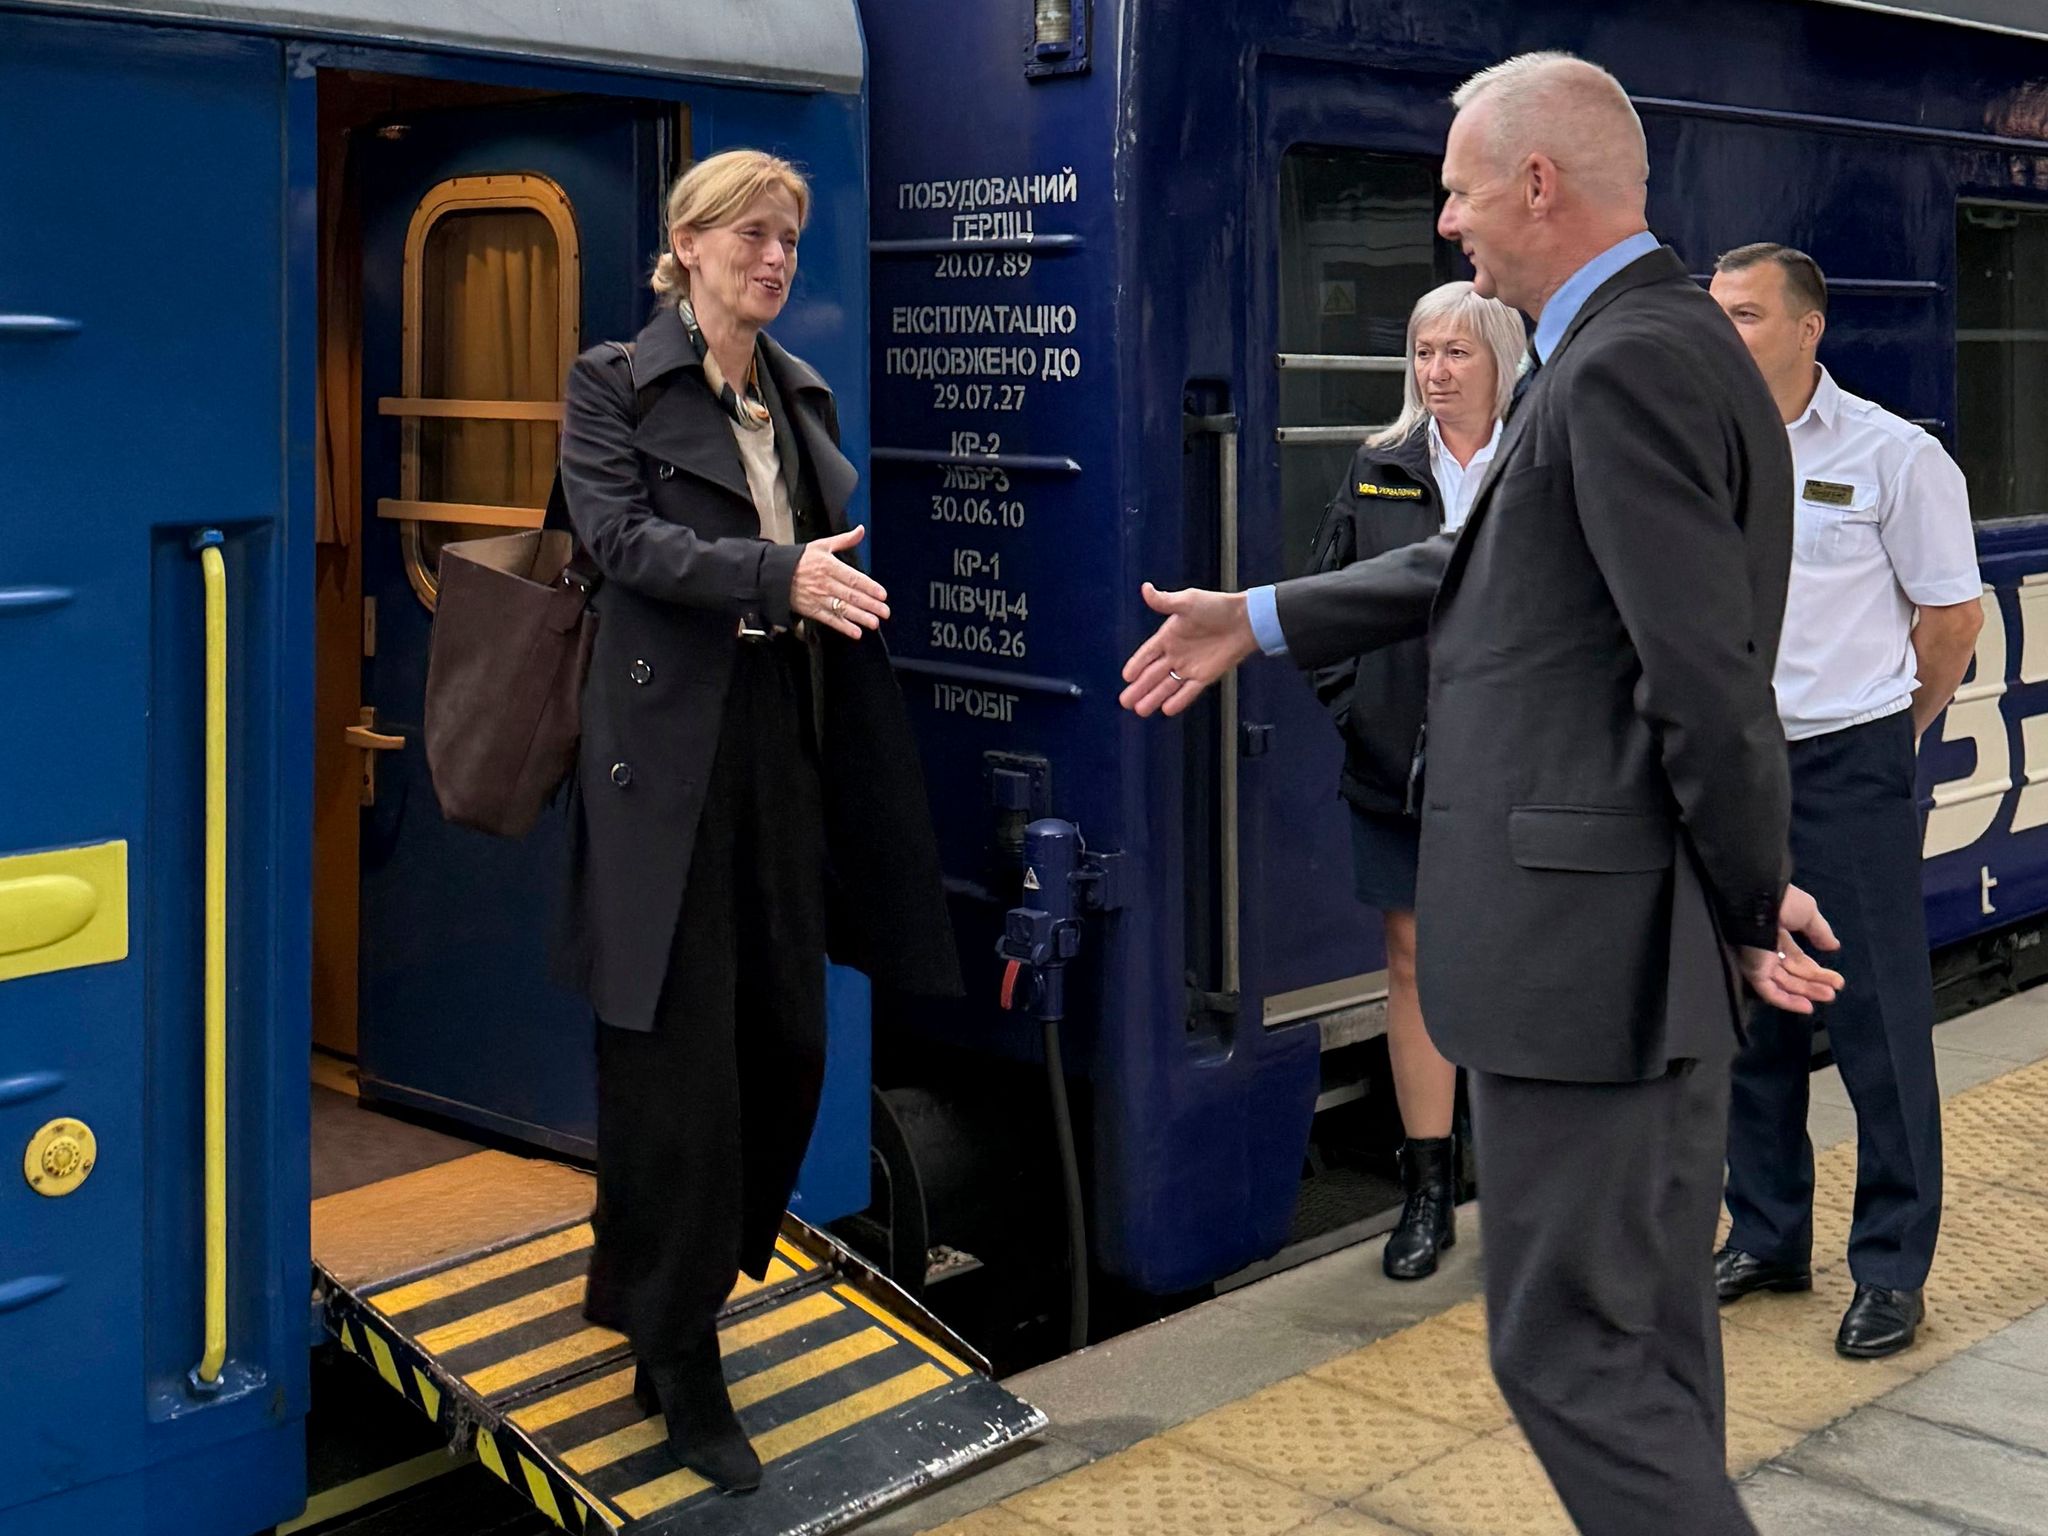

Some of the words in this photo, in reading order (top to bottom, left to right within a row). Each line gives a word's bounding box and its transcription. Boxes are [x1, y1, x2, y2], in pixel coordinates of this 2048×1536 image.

[899, 166, 1077, 210] ПОБУДОВАНИЙ
[952, 210, 1034, 243] ГЕРЛІЦ
[934, 252, 1032, 278] 20.07.89
[892, 304, 1077, 337] ЕКСПЛУАТАЦІЮ
[886, 346, 1037, 380] ПОДОВЖЕНО
[1041, 347, 1081, 382] ДО
[933, 383, 1026, 411] 29.07.27
[950, 431, 1001, 459] КР-2
[930, 495, 1025, 528] 30.06.10
[953, 548, 1000, 580] КР-1
[929, 581, 1028, 623] ПКВЧД-4
[930, 621, 1026, 658] 30.06.26
[934, 683, 1020, 722] ПРОБІГ
